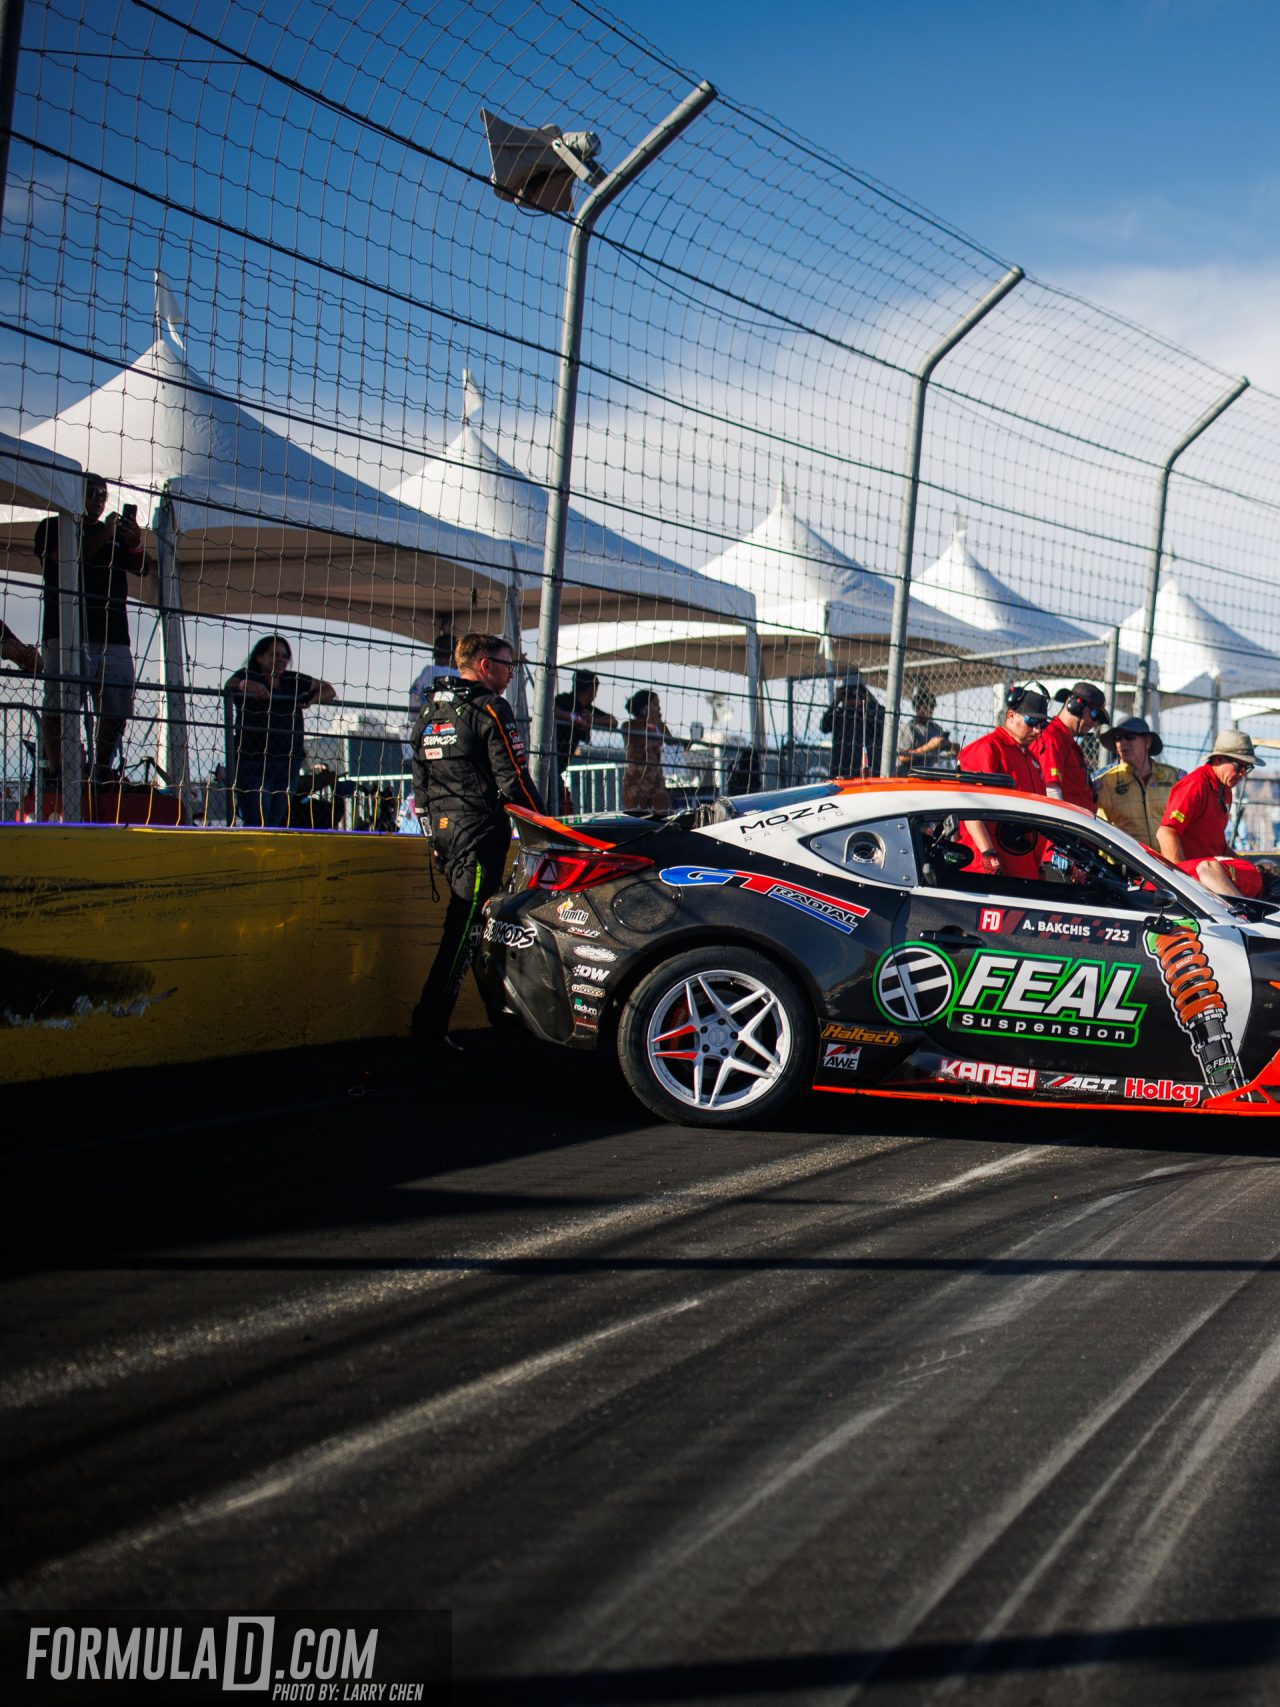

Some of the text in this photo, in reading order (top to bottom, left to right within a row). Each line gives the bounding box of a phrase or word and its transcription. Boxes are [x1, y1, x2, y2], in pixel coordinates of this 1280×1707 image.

[740, 802, 839, 834] MOZA
[744, 811, 844, 843] RACING
[774, 886, 859, 928] RADIAL
[981, 910, 1001, 931] FD
[1022, 919, 1130, 942] A. BAKCHIS 723
[578, 965, 611, 982] DW
[959, 955, 1138, 1022] FEAL
[822, 1024, 901, 1046] Haltech
[961, 1013, 1126, 1040] Suspension
[824, 1056, 858, 1069] AWE
[941, 1060, 1036, 1089] KANSEI
[1212, 1056, 1236, 1069] FEAL
[1060, 1076, 1118, 1090] ACT
[1124, 1077, 1201, 1107] Holley
